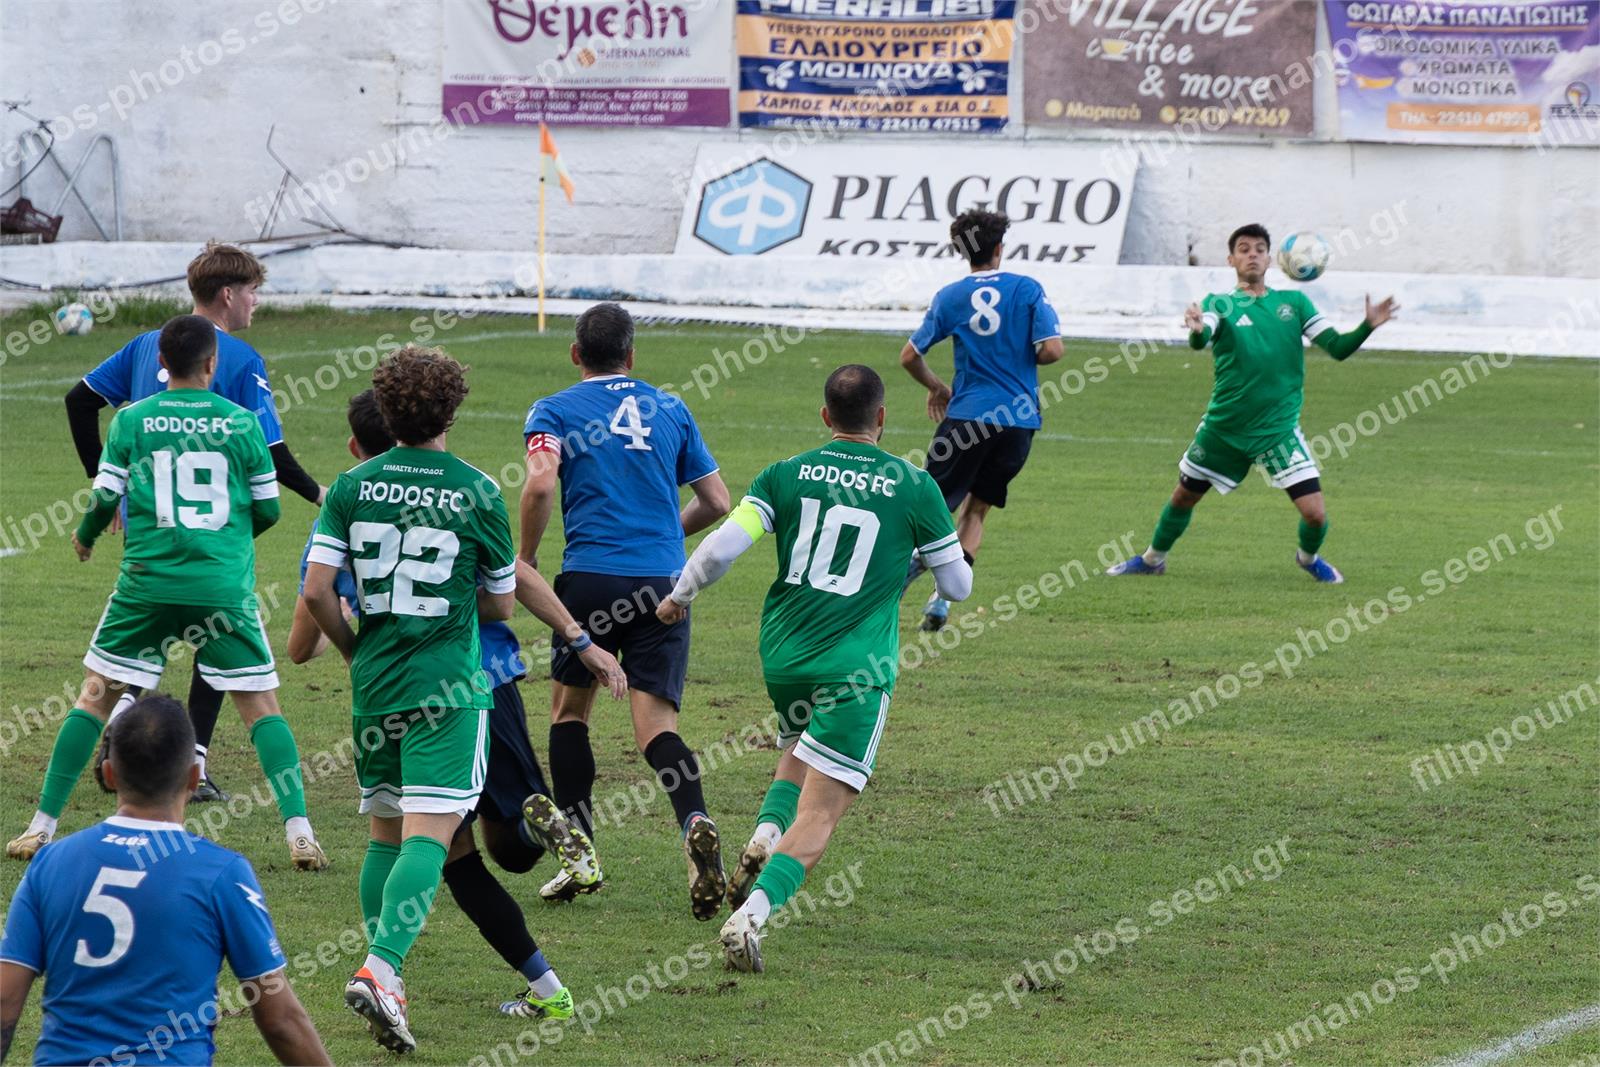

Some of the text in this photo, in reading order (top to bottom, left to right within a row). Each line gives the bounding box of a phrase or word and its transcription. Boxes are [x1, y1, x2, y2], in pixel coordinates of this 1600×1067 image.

[1068, 0, 1259, 38] VILLAGE
[1346, 4, 1589, 26] ΦΩΤΑΡΑΣ ΠΑΝΑΓΙΩΤΗΣ
[768, 21, 886, 38] ΥΠΕΡΣΥΓΧΡΟΝΟ
[769, 37, 983, 58] ΕΛΑΙΟΥΡΓΕΙΟ
[1374, 37, 1560, 56] ΟΙΚΟΔΟΜΙΚΑ ΥΛΙΚΑ
[799, 61, 955, 80] MOLINOVA
[1418, 61, 1511, 75] ΧΡΩΜΑΤΑ
[1138, 64, 1269, 101] & more
[1412, 81, 1517, 96] ΜΟΝΩΤΙΚΑ
[756, 94, 822, 110] ΧΑΡΠΟΣ
[934, 99, 959, 112] ΣΙΑ
[881, 117, 931, 131] 22410
[823, 174, 1122, 226] PIAGGIO
[969, 286, 1001, 337] 8
[143, 415, 233, 434] RODOS FC
[609, 394, 652, 451] 4
[383, 464, 412, 474] ΕΙΜΑΣΤΕ
[419, 467, 445, 476] ΡΟΔΟΣ
[798, 464, 896, 497] RODOS FC
[151, 450, 231, 532] 19
[359, 480, 464, 513] RODOS FC
[784, 497, 881, 597] 10
[349, 521, 460, 617] 22
[73, 866, 148, 968] 5
